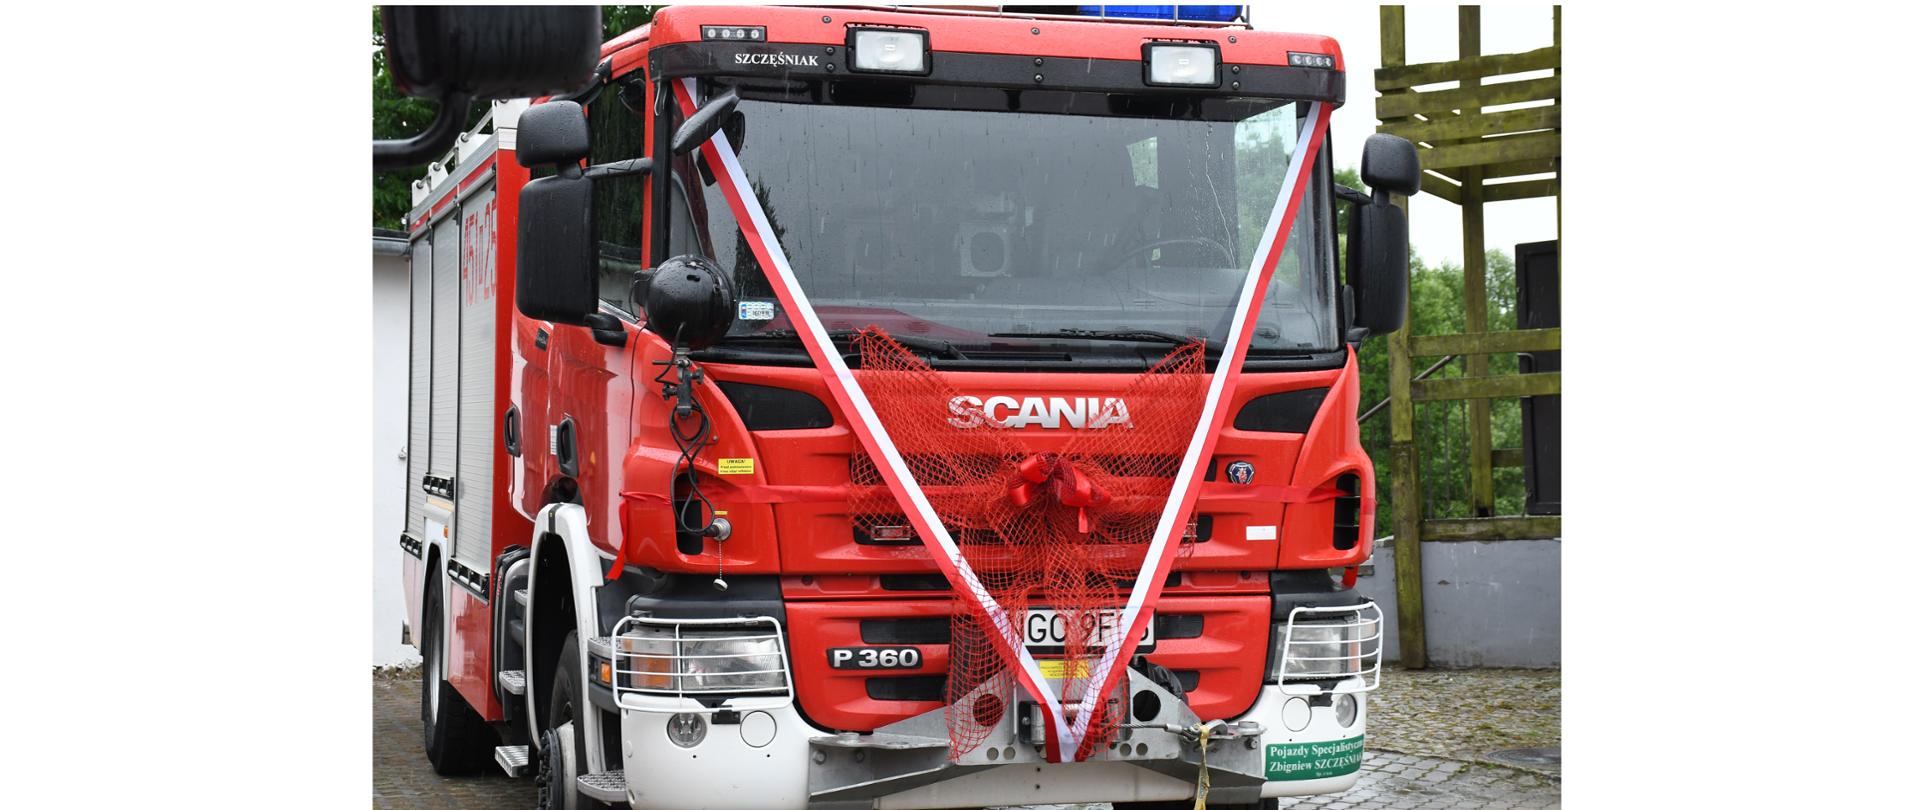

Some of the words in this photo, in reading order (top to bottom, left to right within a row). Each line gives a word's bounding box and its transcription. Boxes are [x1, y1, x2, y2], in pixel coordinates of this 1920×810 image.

[735, 51, 819, 67] SZCZĘŚNIAK
[948, 395, 1134, 429] SCANIA
[833, 649, 853, 668] P
[858, 648, 919, 667] 360
[1270, 746, 1309, 758] Pojazdy
[1269, 761, 1312, 773] Zbigniew
